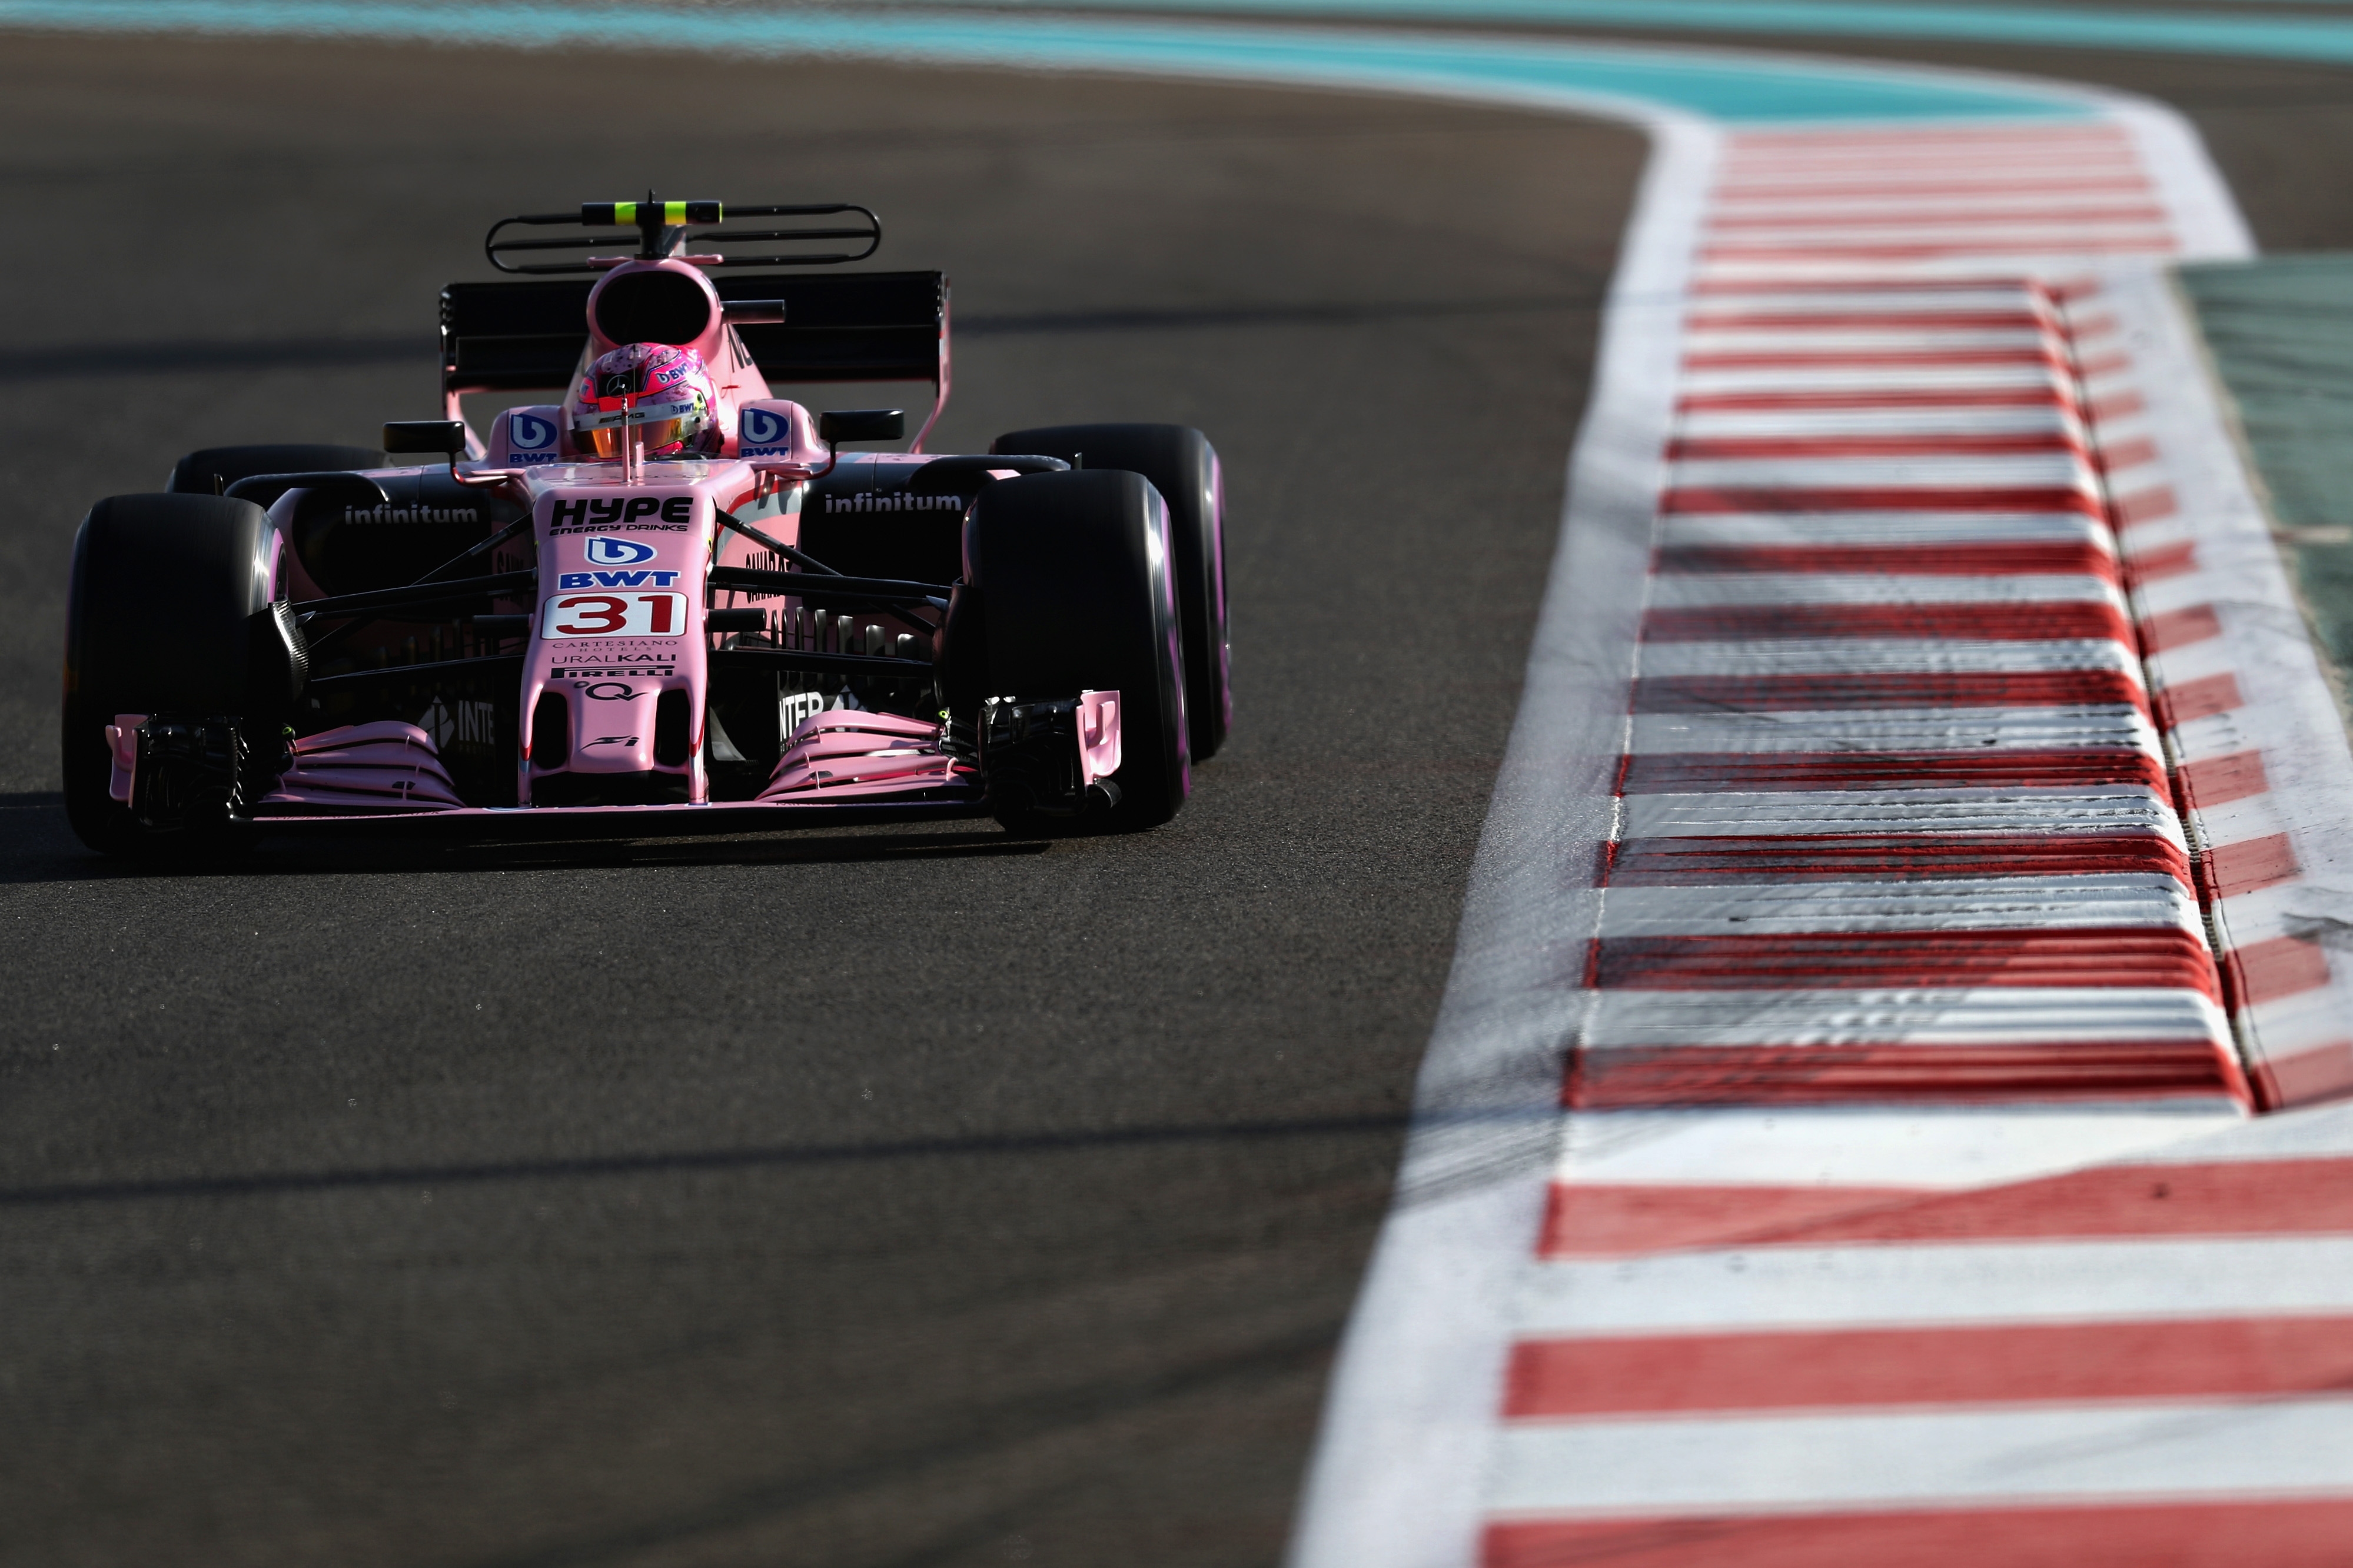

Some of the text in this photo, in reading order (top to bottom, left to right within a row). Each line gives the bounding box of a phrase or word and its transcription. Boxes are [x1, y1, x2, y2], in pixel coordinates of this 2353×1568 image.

[509, 453, 557, 462] BWT
[740, 447, 789, 457] BWT
[825, 491, 962, 513] infinitum
[345, 504, 478, 525] infinitum
[550, 497, 694, 527] HYPE
[549, 524, 621, 536] ENERGY
[559, 570, 680, 590] BWT
[556, 595, 673, 634] 31
[552, 640, 677, 648] CARTESIANO
[551, 654, 676, 664] URALKALI
[550, 665, 675, 679] PIRELLI
